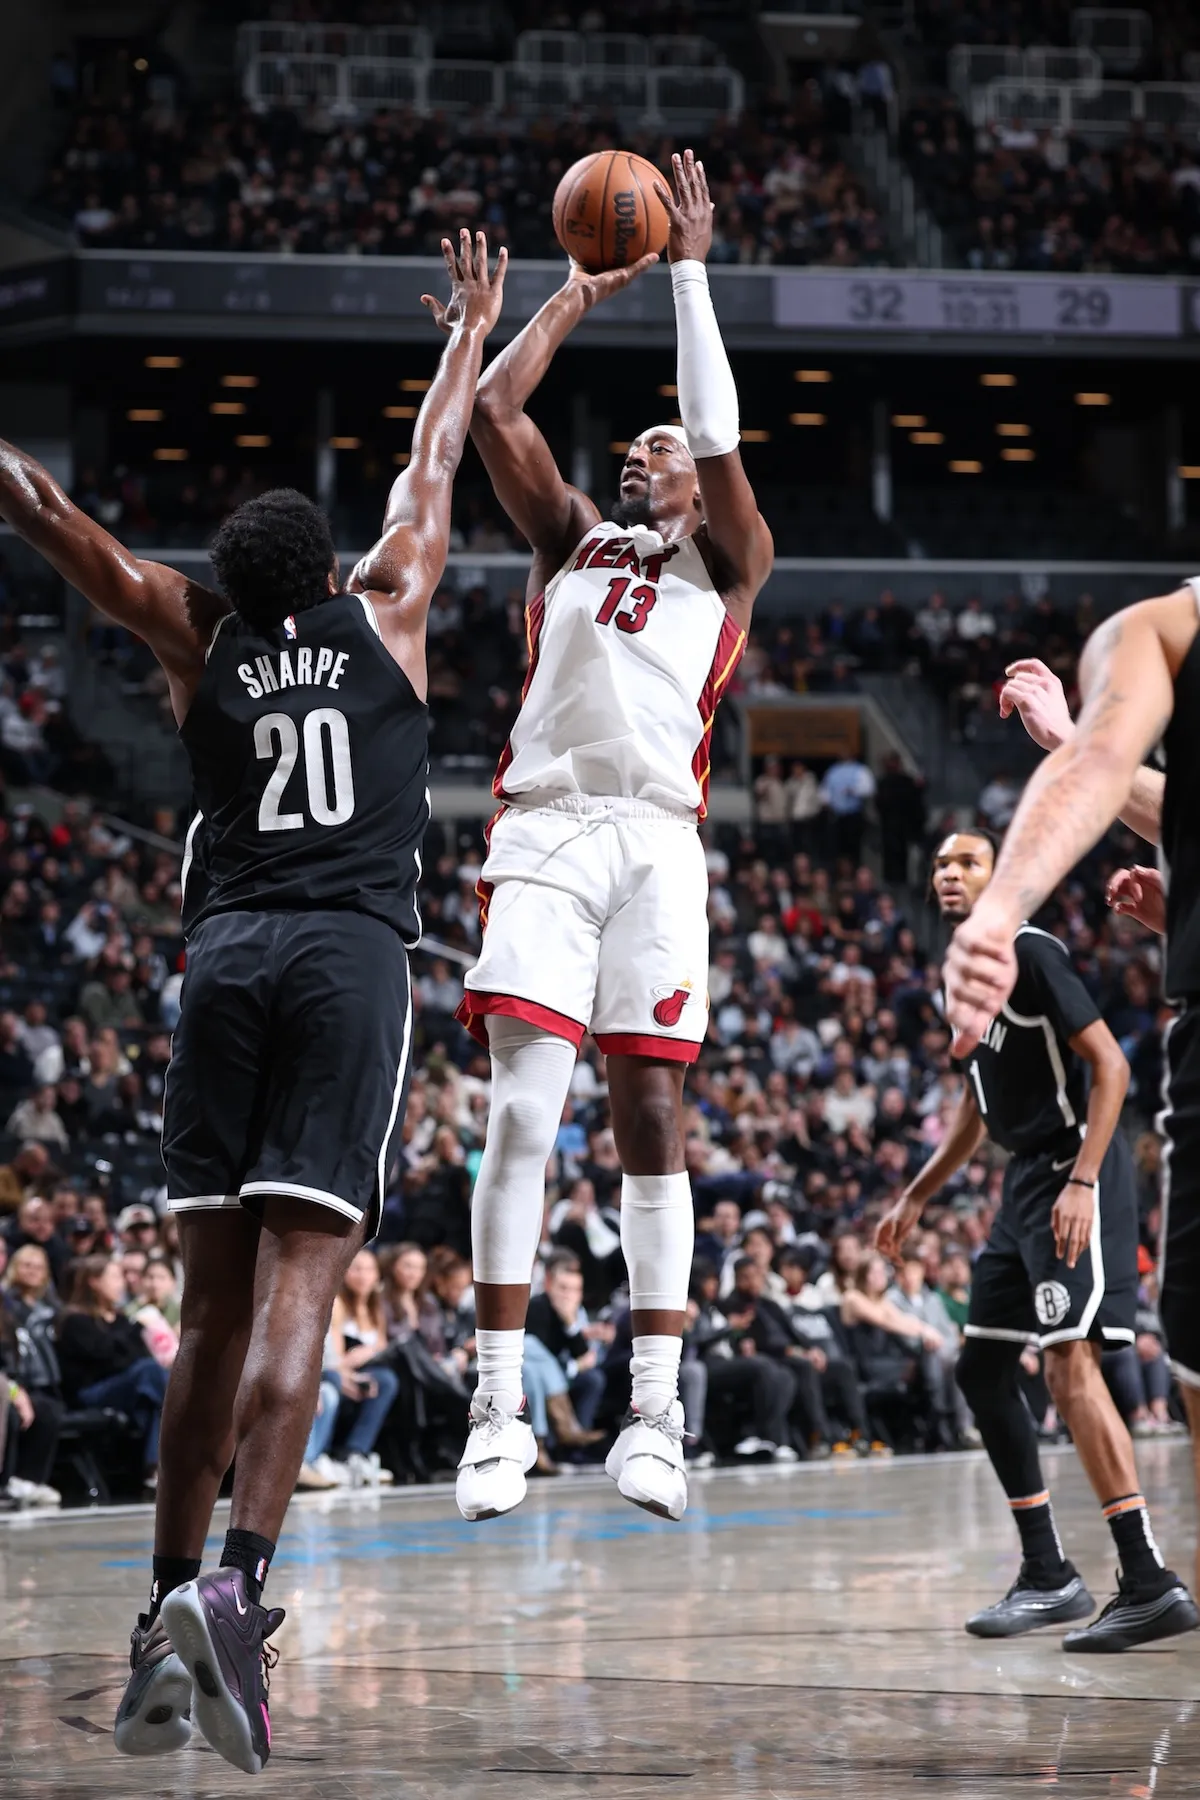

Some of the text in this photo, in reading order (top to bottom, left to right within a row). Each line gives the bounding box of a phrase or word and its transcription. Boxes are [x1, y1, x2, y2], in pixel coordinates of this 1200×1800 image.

[848, 284, 904, 322] 32
[1056, 287, 1112, 327] 29
[595, 577, 657, 634] 13
[237, 647, 350, 699] SHARPE
[253, 707, 355, 832] 20
[969, 1060, 988, 1114] 1
